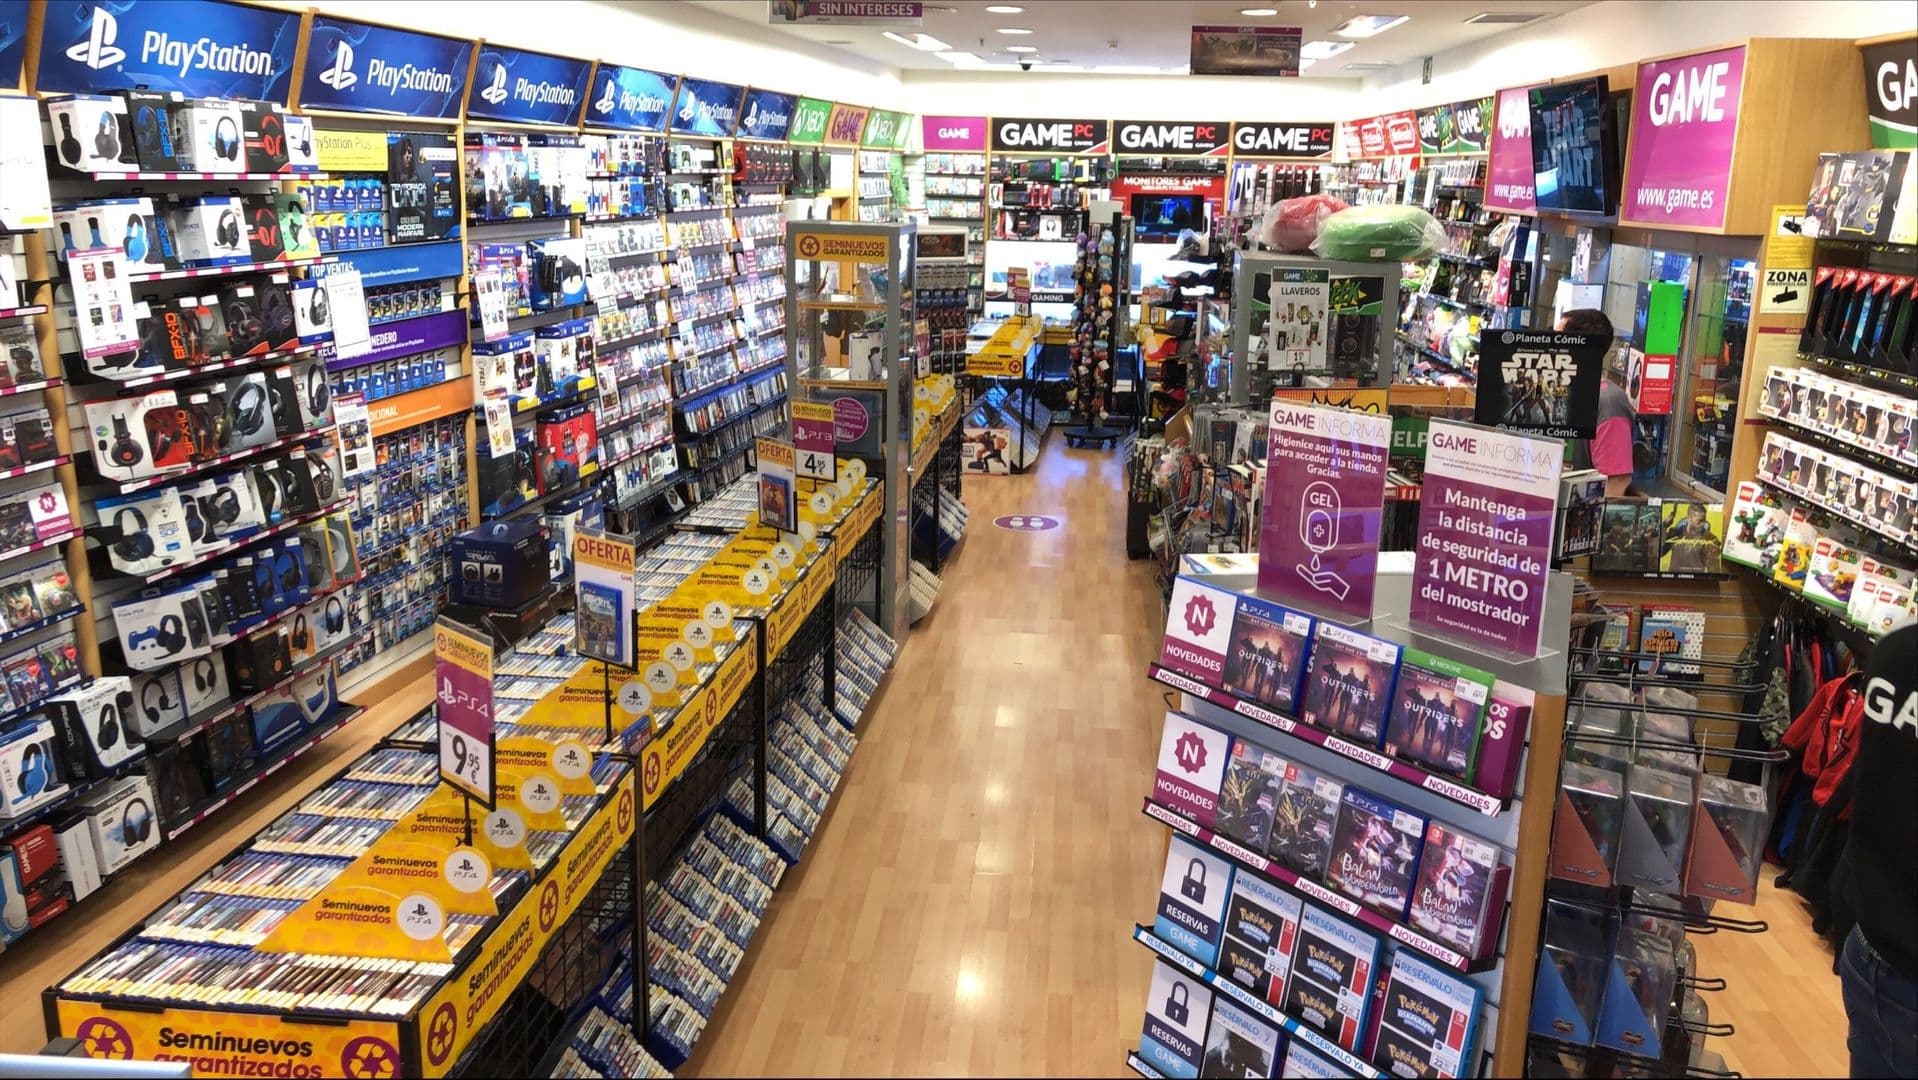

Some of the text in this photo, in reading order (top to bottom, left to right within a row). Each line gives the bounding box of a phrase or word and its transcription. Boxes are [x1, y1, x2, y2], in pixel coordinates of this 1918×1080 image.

[819, 3, 914, 16] SIN INTERESES
[142, 30, 272, 78] PlayStation
[367, 59, 451, 96] PlayStation
[515, 77, 574, 104] PlayStation
[619, 91, 663, 114] PlayStation
[1650, 62, 1729, 126] GAME
[807, 109, 826, 131] XBOX
[832, 109, 864, 142] GAME
[1419, 114, 1439, 138] GAME
[1457, 107, 1479, 134] GAME
[938, 127, 969, 139] GAME
[1000, 123, 1093, 147] GAME PC
[1121, 125, 1215, 149] GAME PC
[1235, 126, 1330, 151] GAME PC
[1124, 177, 1212, 186] MONITORES GAME
[1637, 186, 1713, 213] www.game.es
[823, 239, 885, 250] SEMINUEVOS
[823, 249, 885, 258] GARANTIZADOS
[311, 262, 354, 277] TOP VENTAS
[1767, 271, 1807, 283] ZONA
[1032, 294, 1063, 302] GAMING
[1281, 286, 1320, 296] LLAVEROS
[1516, 333, 1586, 344] Planeta Cómic
[1502, 353, 1577, 369] STAR
[1502, 368, 1577, 385] WARS
[809, 431, 832, 440] PS3
[1274, 410, 1386, 442] GAME INFORMA
[1546, 427, 1578, 437] Cómic
[758, 442, 793, 461] OFERTA
[1274, 434, 1314, 450] Higienice
[1315, 443, 1335, 455] aquí
[1335, 447, 1350, 456] sus
[1352, 451, 1382, 463] manos
[1274, 447, 1378, 474] para acceder a la tienda.
[1432, 432, 1477, 454] GAME
[1479, 439, 1553, 469] INFORMA
[804, 454, 816, 473] 4
[1307, 464, 1342, 479] Gracias.
[1310, 492, 1333, 508] GEL
[1445, 488, 1526, 520] Mantenga
[1439, 511, 1528, 546] la distancia
[577, 538, 632, 564] OFERTA
[1422, 533, 1541, 575] de seguridad de
[1429, 558, 1529, 601] 1 METRO
[1190, 606, 1208, 629] N
[1249, 607, 1270, 618] PS4
[1421, 584, 1530, 626] del mostrador
[448, 637, 488, 663] SEMINUEVOS
[1166, 644, 1221, 673] NOVEDADES
[1239, 649, 1288, 673] OUTRIDERS
[1159, 670, 1203, 697] NOVEDADES
[1321, 676, 1375, 701] OUTRIDERS
[457, 690, 488, 717] PS4
[1239, 701, 1292, 731] NOVEDADES
[1404, 701, 1464, 728] OUTRIDERS
[1305, 712, 1315, 725] 18
[452, 735, 467, 775] 9
[1182, 742, 1199, 762] N
[1328, 737, 1383, 768] NOVEDADES
[1385, 743, 1396, 755] 18
[1157, 779, 1213, 810] NOVEDADES
[1356, 797, 1379, 812] PS4
[1428, 778, 1491, 811] NOVEDADES
[491, 828, 516, 836] PS4
[1150, 807, 1193, 834] NOVEDADES
[566, 817, 612, 878] Seminuevos
[1214, 839, 1261, 867] NOVEDADES
[367, 865, 439, 879] garantizados
[373, 855, 438, 868] Seminuevos
[564, 832, 614, 906] garantizados
[1342, 853, 1381, 881] BALAN
[454, 871, 478, 880] PS4
[321, 899, 391, 914] Seminuevos
[1300, 881, 1351, 913] NOVEDADES
[1423, 888, 1458, 913] BALAN
[315, 909, 392, 925] garantizados
[406, 915, 432, 926] PS4
[1166, 903, 1209, 934] RESERVAS
[1169, 926, 1199, 951] GAME
[1394, 927, 1453, 962] NOVEDADES
[468, 915, 531, 997] Seminuevos
[1186, 959, 1195, 969] YA
[466, 932, 535, 1029] garantizados
[1264, 1006, 1274, 1018] YA
[1399, 994, 1440, 1024] Pokémon
[159, 1027, 313, 1057] Seminuevos
[1151, 1024, 1192, 1057] RESERVAS
[154, 1051, 322, 1079] garantizados
[1154, 1047, 1181, 1071] GAME
[1353, 1058, 1365, 1070] YA
